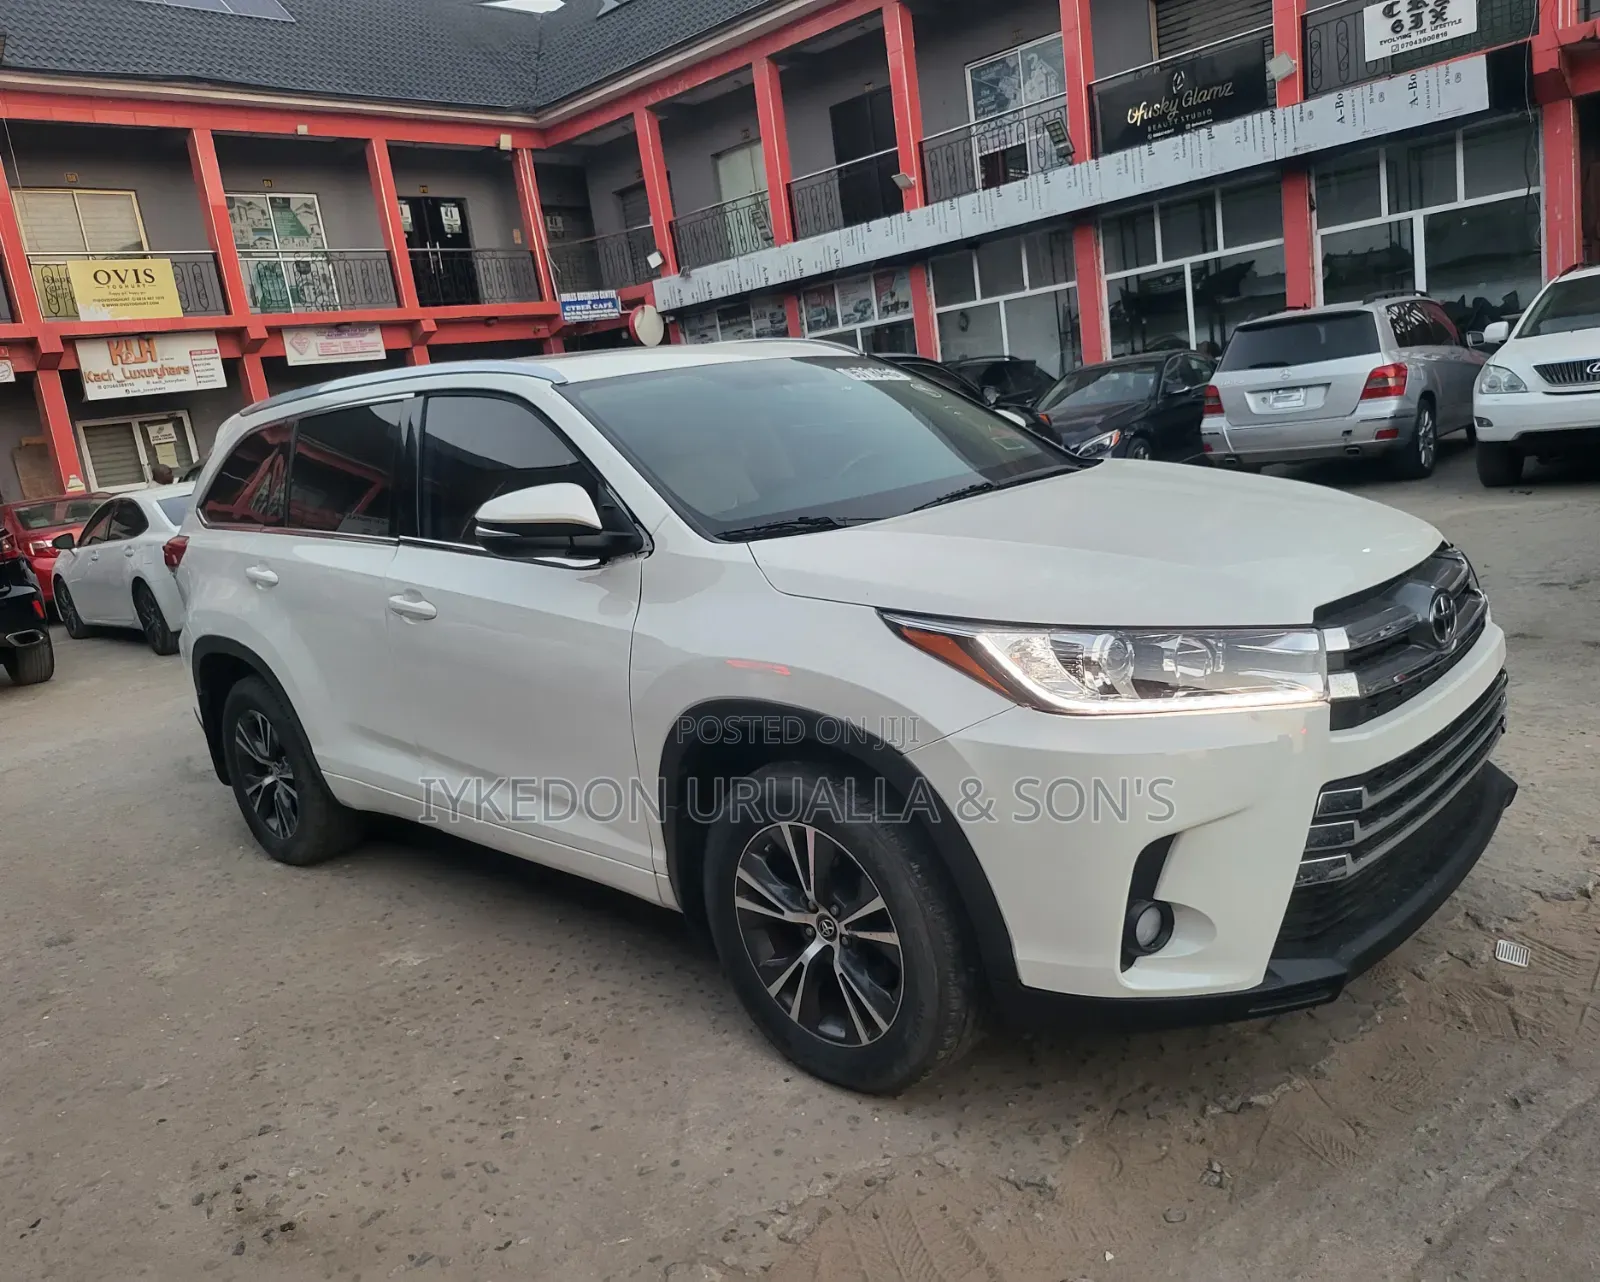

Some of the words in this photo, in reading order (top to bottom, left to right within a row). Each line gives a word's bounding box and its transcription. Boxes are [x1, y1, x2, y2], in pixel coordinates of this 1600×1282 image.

[1379, 33, 1412, 46] EVOLVING
[1416, 28, 1427, 36] THE
[1430, 18, 1462, 32] LIFESTYLE
[1182, 82, 1234, 108] Glamz
[1147, 118, 1178, 132] BEAUTY
[1181, 108, 1213, 123] STUDIO
[93, 268, 156, 286] OVIS
[565, 304, 592, 312] CYBER
